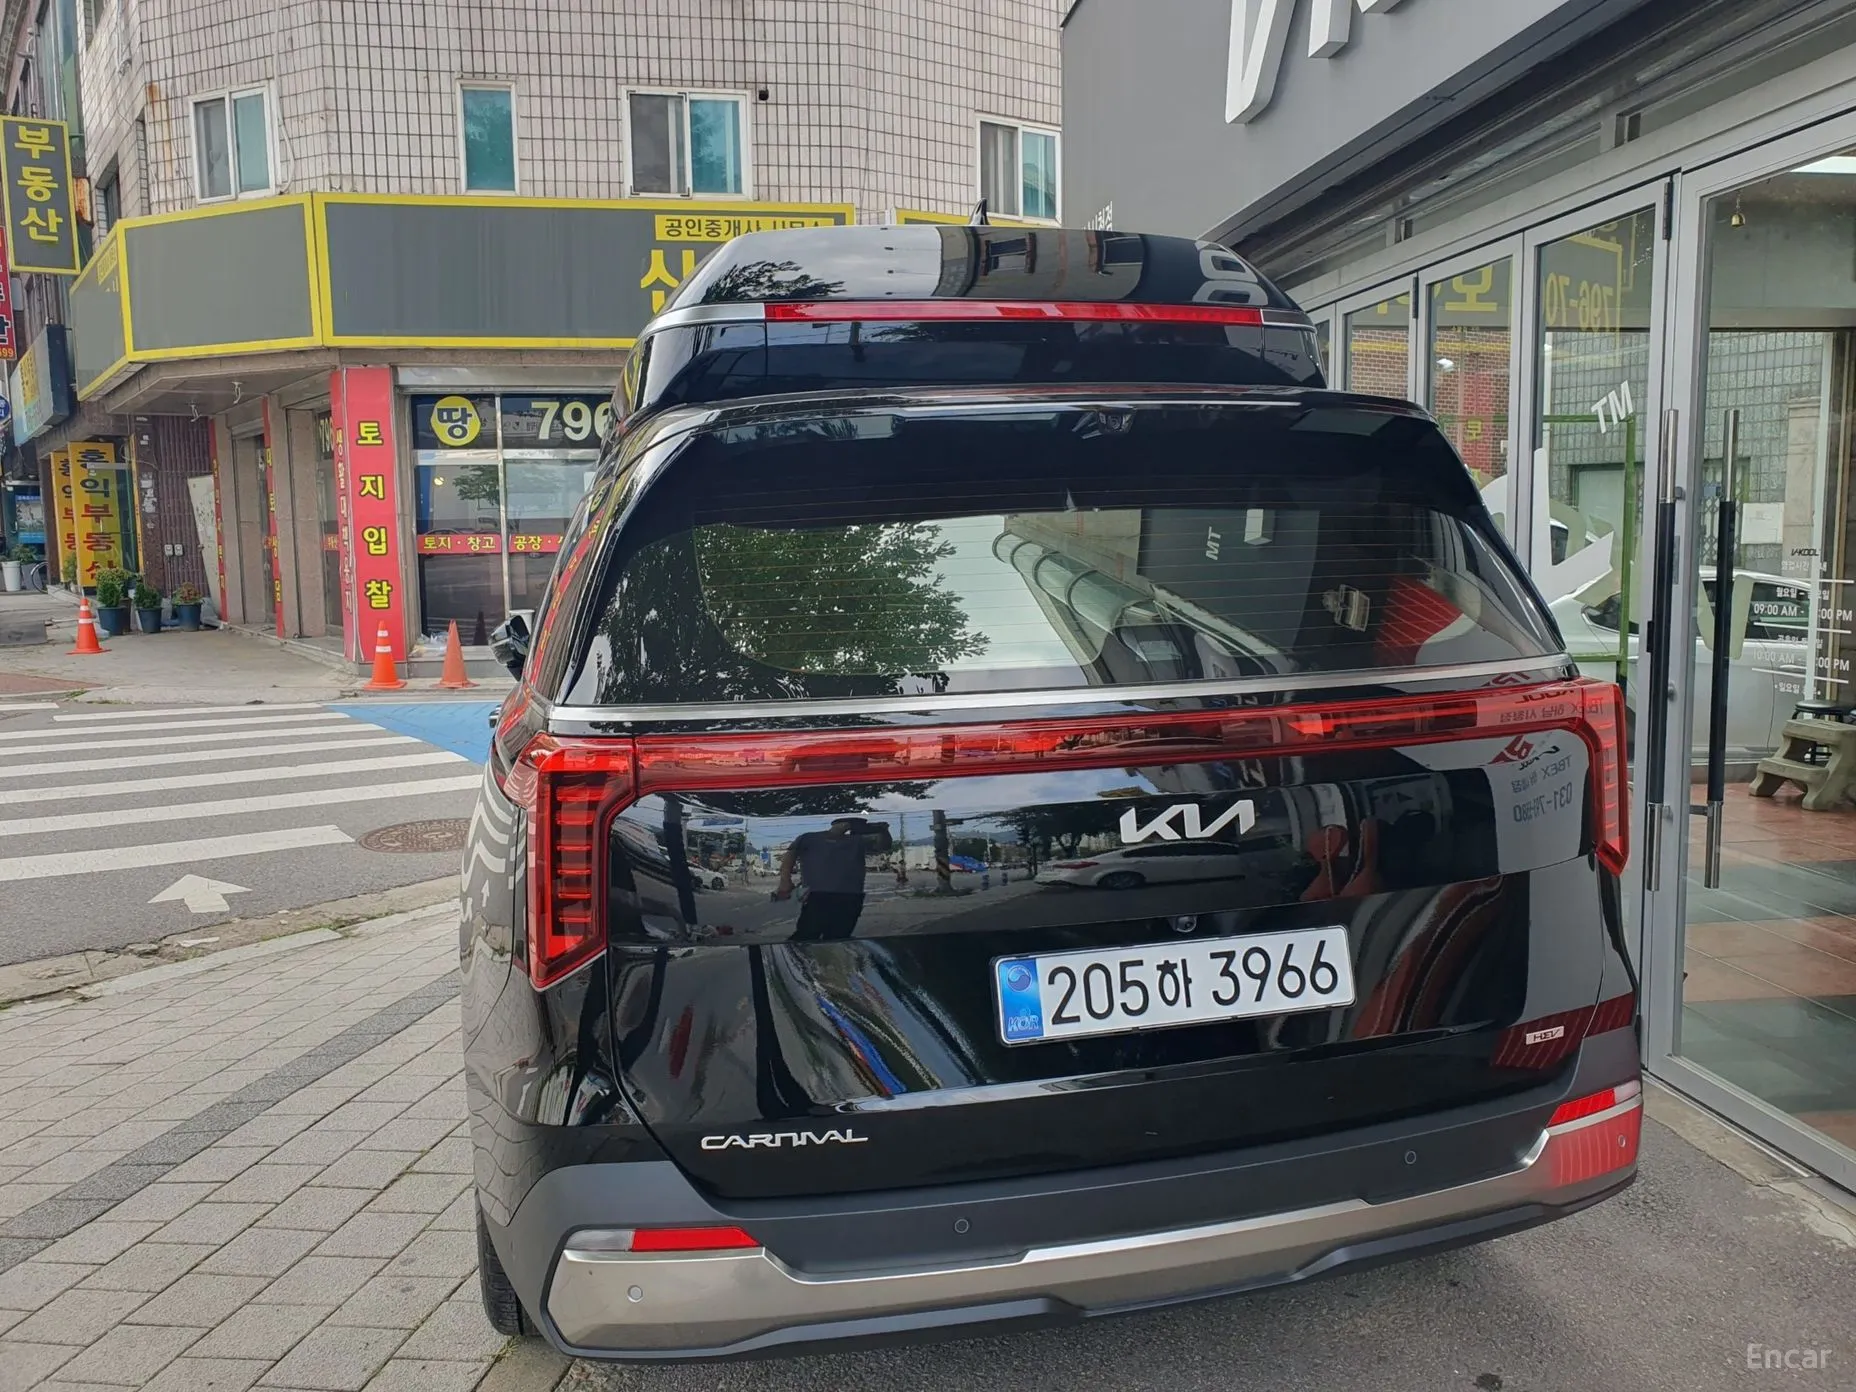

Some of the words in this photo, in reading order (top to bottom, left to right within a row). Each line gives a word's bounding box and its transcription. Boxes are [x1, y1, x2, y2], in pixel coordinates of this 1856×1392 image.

[14, 125, 64, 243] 부동산
[1591, 379, 1634, 434] TM
[437, 407, 473, 439] 땅
[356, 421, 393, 609] 토지입찰
[423, 536, 451, 550] 토지
[467, 536, 495, 550] 창고
[513, 536, 542, 550] 공장
[1753, 603, 1779, 615] 09:00
[1781, 605, 1797, 617] AM
[1836, 608, 1853, 621] PM
[1832, 657, 1850, 671] PM
[1119, 799, 1256, 844] KIA
[1047, 957, 1193, 1026] 205하
[1209, 940, 1338, 1007] 3966
[1533, 1029, 1560, 1042] HEV
[701, 1129, 869, 1150] CARNIVAL
